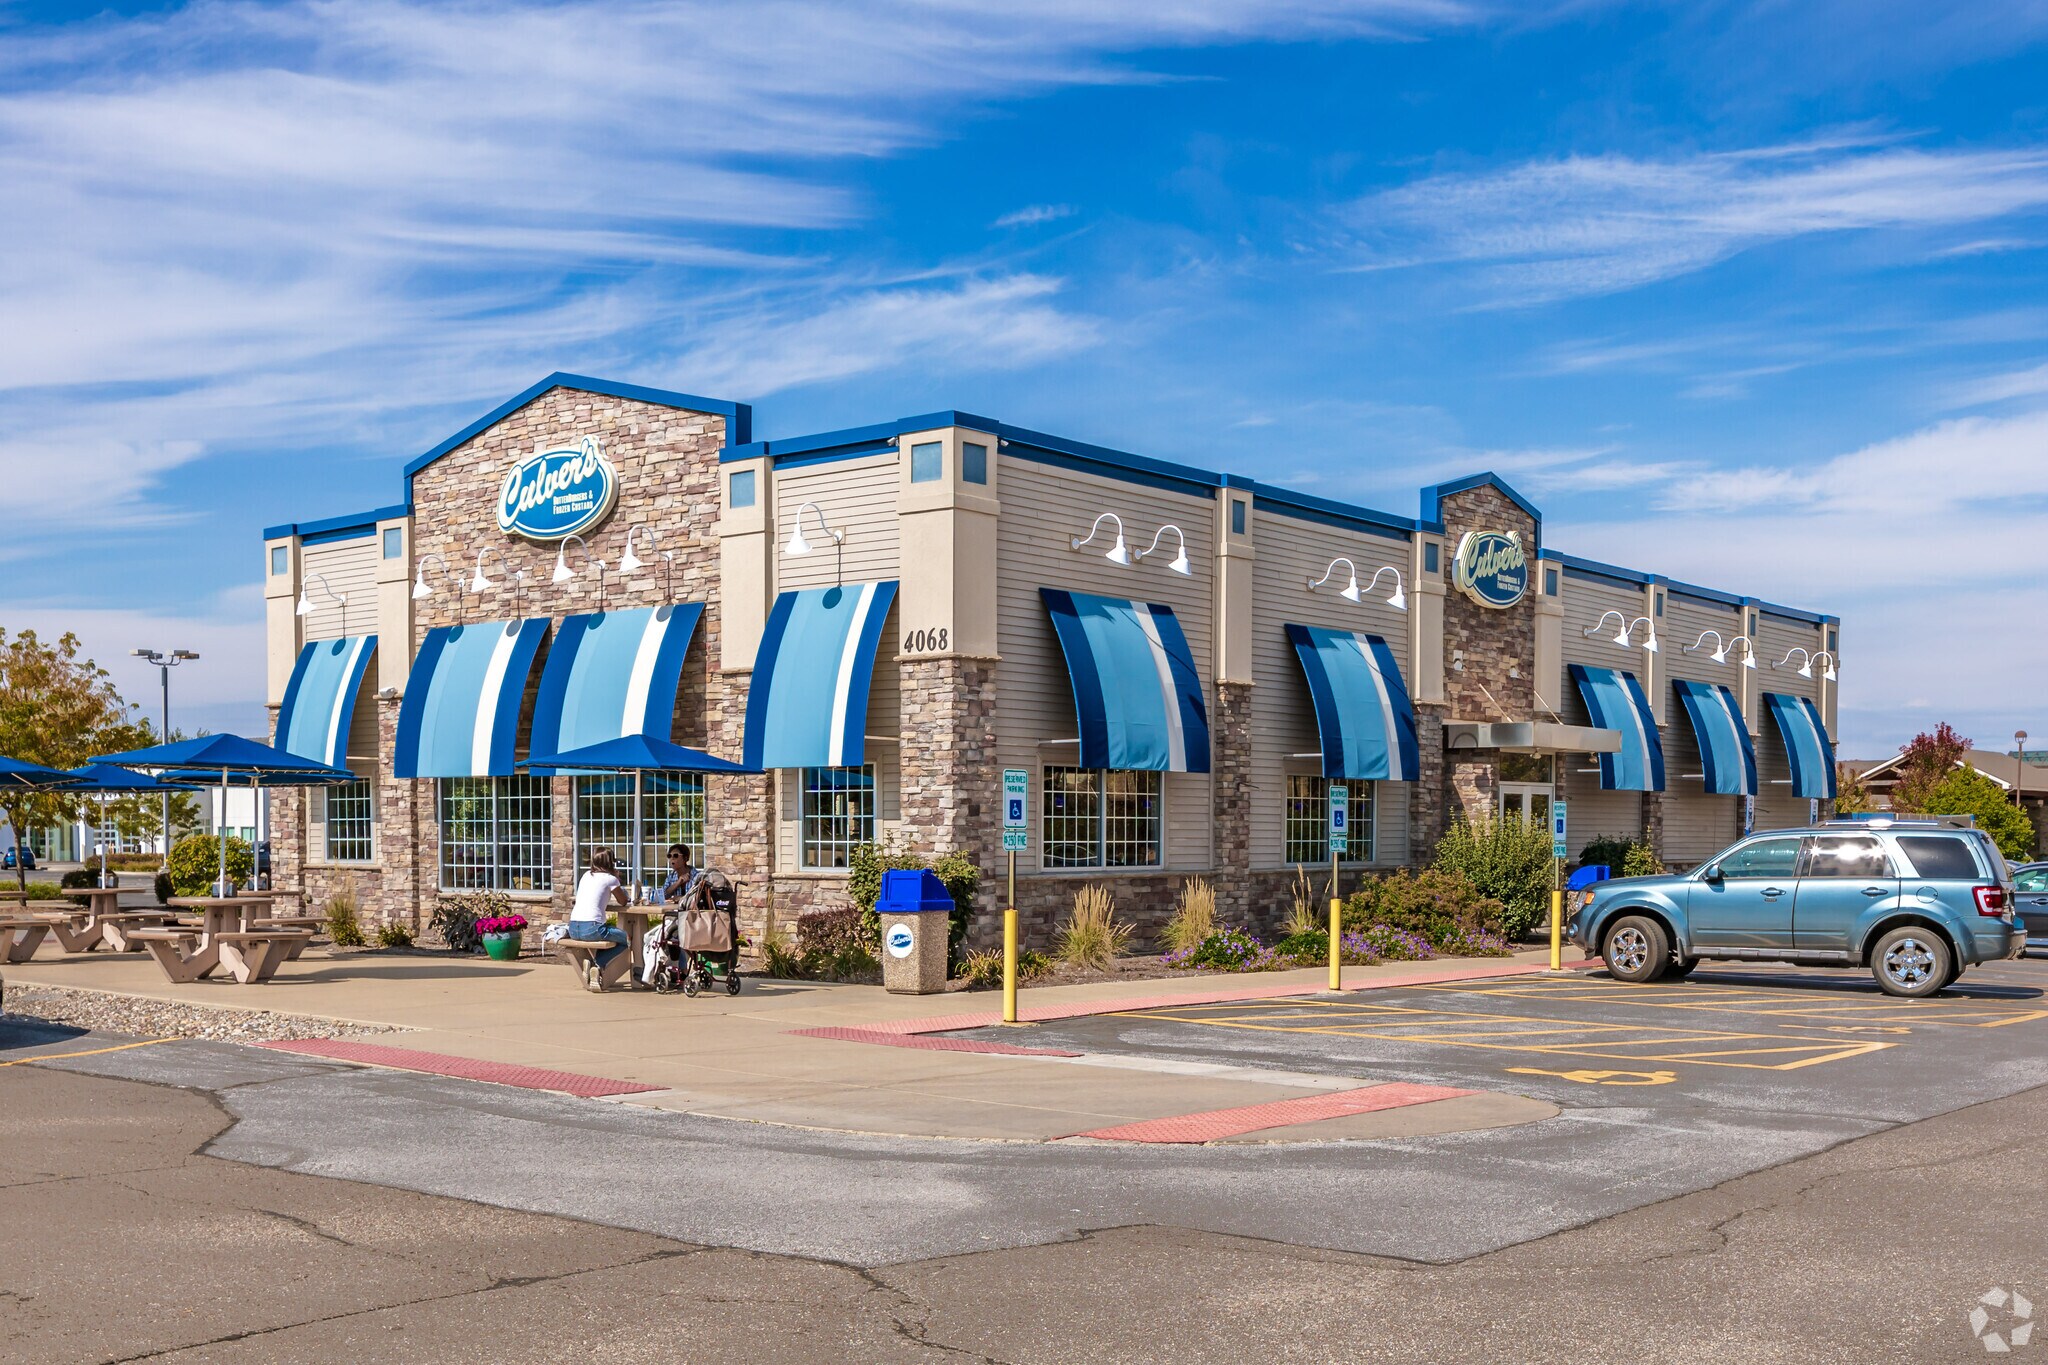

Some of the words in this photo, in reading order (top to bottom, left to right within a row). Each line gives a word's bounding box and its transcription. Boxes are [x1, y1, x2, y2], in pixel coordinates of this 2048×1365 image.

[500, 438, 597, 527] Culver's
[1464, 534, 1523, 586] Culver's
[904, 627, 948, 653] 4068
[1005, 775, 1026, 783] RESERVED
[1007, 785, 1025, 793] PARKING
[1017, 835, 1026, 846] FINE
